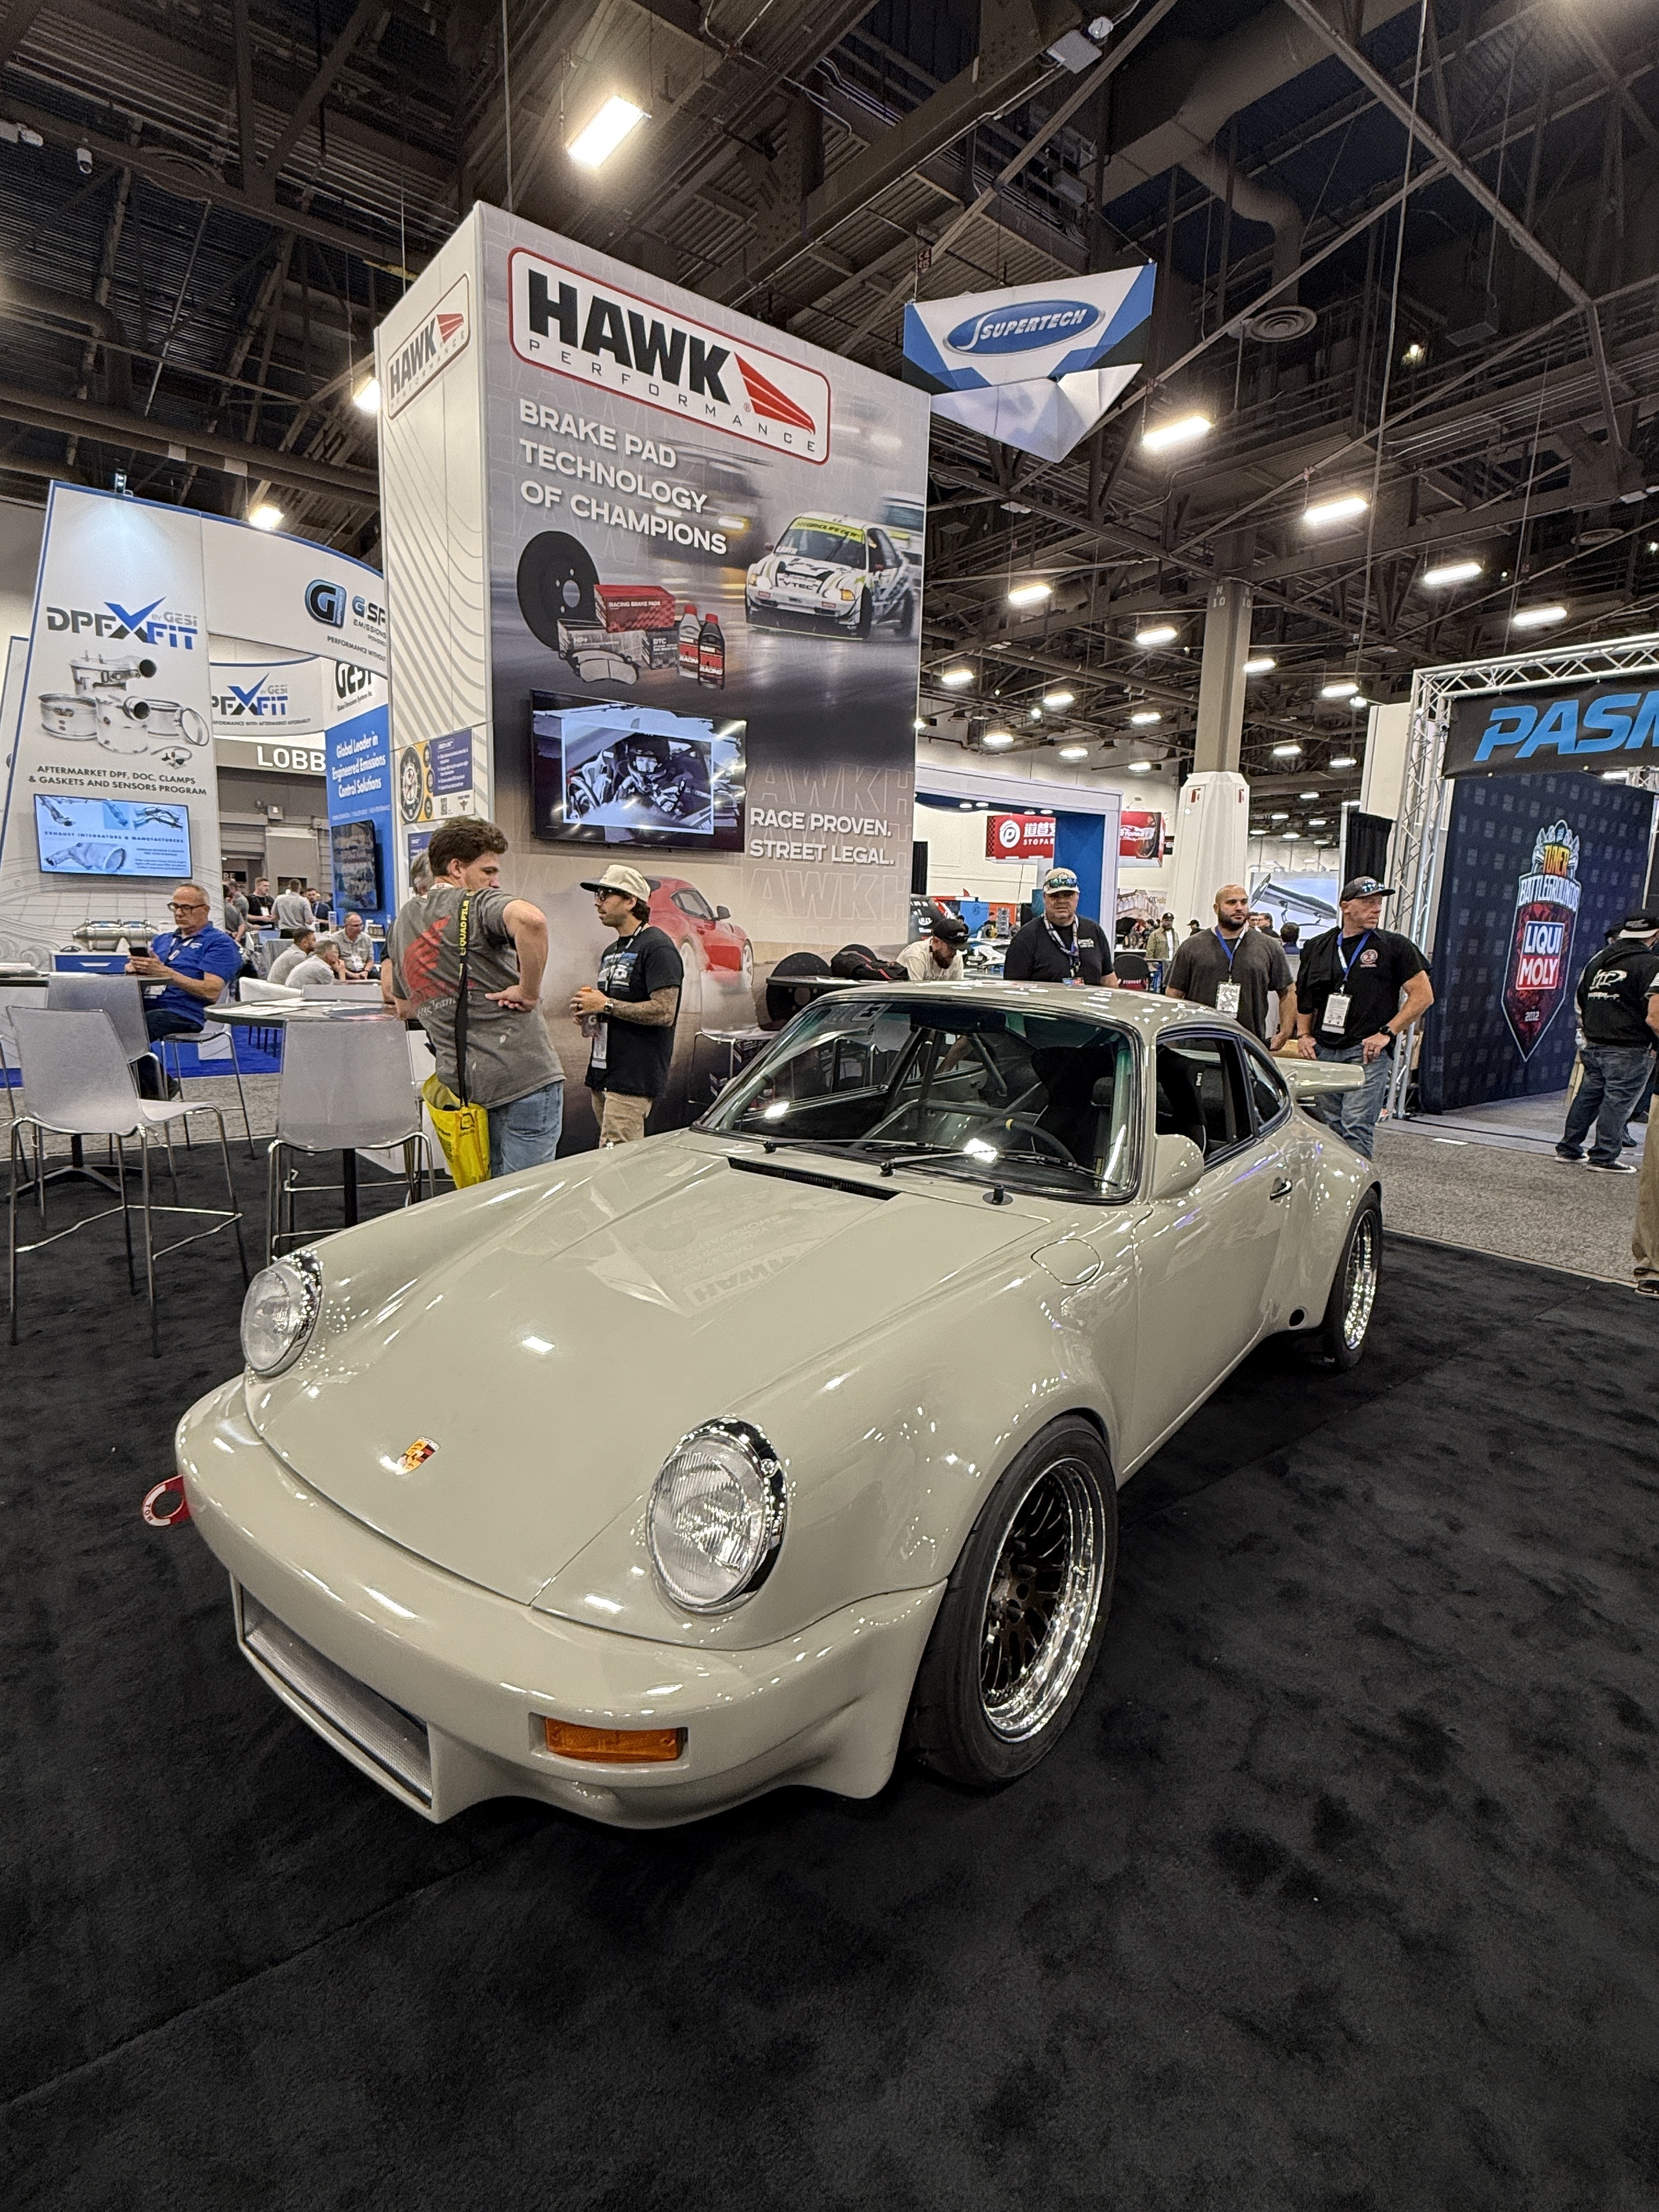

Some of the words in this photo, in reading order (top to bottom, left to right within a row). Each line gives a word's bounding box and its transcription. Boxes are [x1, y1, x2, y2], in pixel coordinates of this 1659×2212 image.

[529, 269, 731, 405] HAWK
[979, 308, 1087, 340] SUPERTECH
[390, 317, 437, 399] HAWK
[529, 340, 815, 452] PERFORMANCE
[520, 398, 616, 450] BRAKE
[625, 433, 676, 468] PAD
[519, 439, 708, 513] TECHNOLOGY
[521, 480, 562, 507] OF
[571, 494, 726, 554] CHAMPIONS
[783, 581, 813, 590] VTEC
[257, 746, 326, 771] LOBB
[336, 739, 353, 758] Global
[353, 733, 371, 753] Leader
[371, 730, 379, 746] in
[37, 766, 107, 777] AFTERMARKET
[110, 771, 130, 780] DPF,
[133, 772, 156, 782] DOC,
[159, 775, 196, 785] CLAMPS
[332, 758, 360, 782] Engineered
[360, 752, 386, 772] Emissions
[40, 776, 84, 786] GASKETS
[87, 780, 110, 788] AND
[112, 781, 156, 791] SENSORS
[160, 785, 207, 795] PROGRAM
[338, 780, 357, 798] Control
[357, 775, 382, 794] Solutions
[751, 808, 805, 829] RACE
[810, 813, 891, 837] PROVEN.
[750, 839, 826, 861] STREET
[832, 845, 894, 865] LEGAL.
[1543, 845, 1570, 877] TUNER
[1518, 875, 1580, 912] BATTLEGROUNDS
[1524, 925, 1562, 956] LIQUI
[1519, 958, 1559, 986] MOLY
